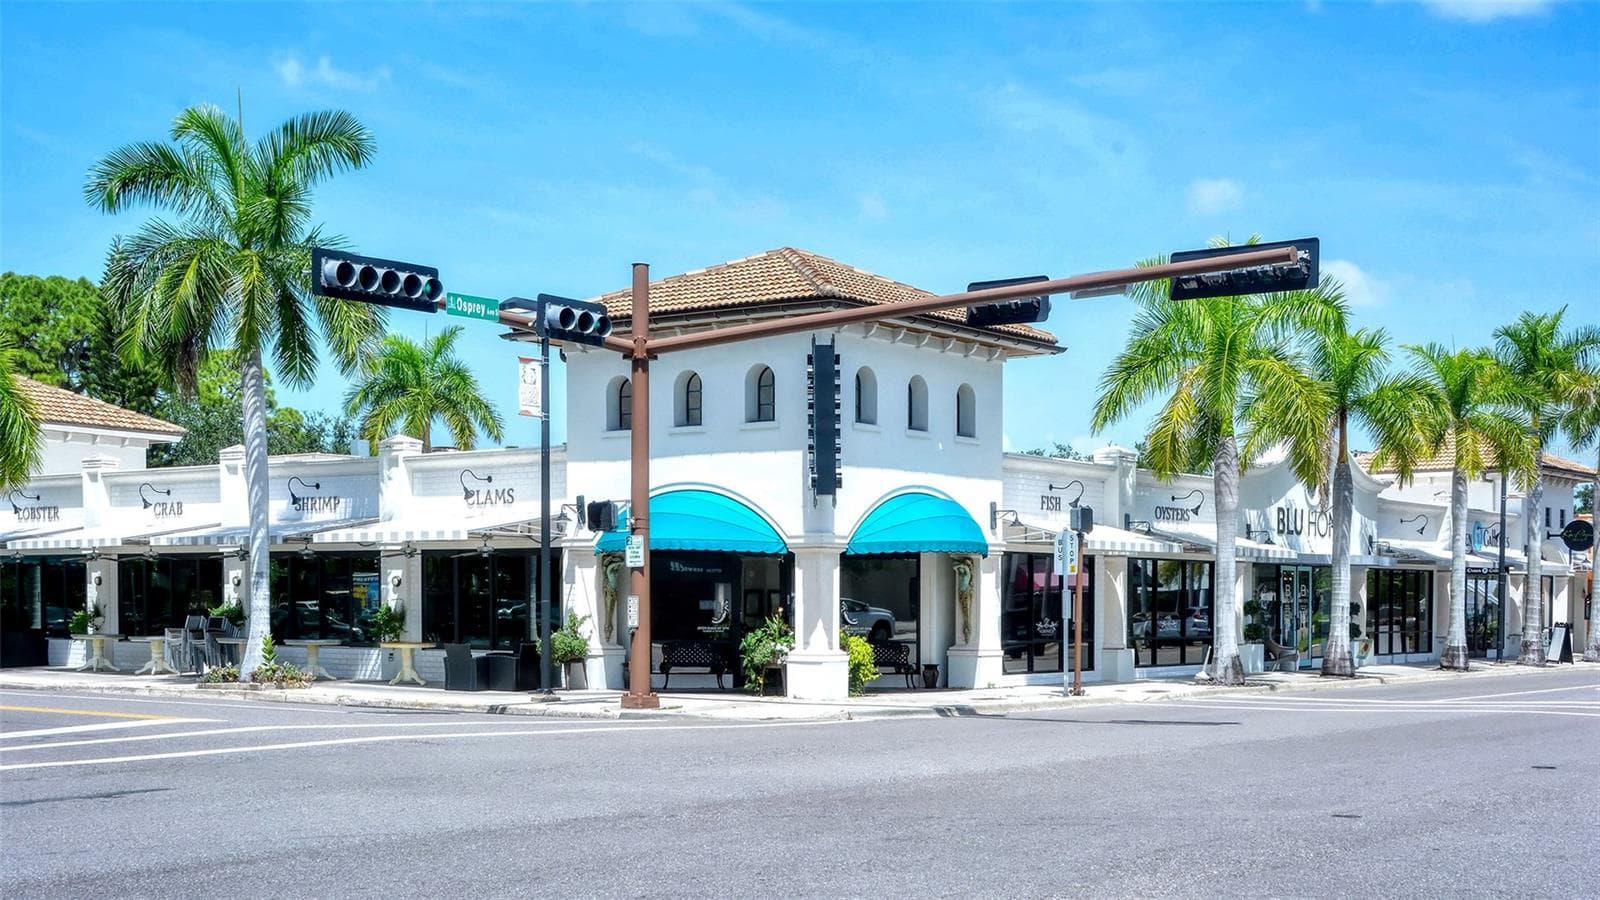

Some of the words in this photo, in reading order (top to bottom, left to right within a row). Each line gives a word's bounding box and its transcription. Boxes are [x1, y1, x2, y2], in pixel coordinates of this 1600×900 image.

[456, 297, 486, 317] Osprey
[294, 496, 340, 512] SHRIMP
[466, 487, 515, 506] CLAMS
[1040, 495, 1062, 511] FISH
[17, 506, 60, 521] LOBSTER
[153, 501, 183, 517] CRAB
[1154, 505, 1191, 521] OYSTERS
[1277, 507, 1303, 535] BLU
